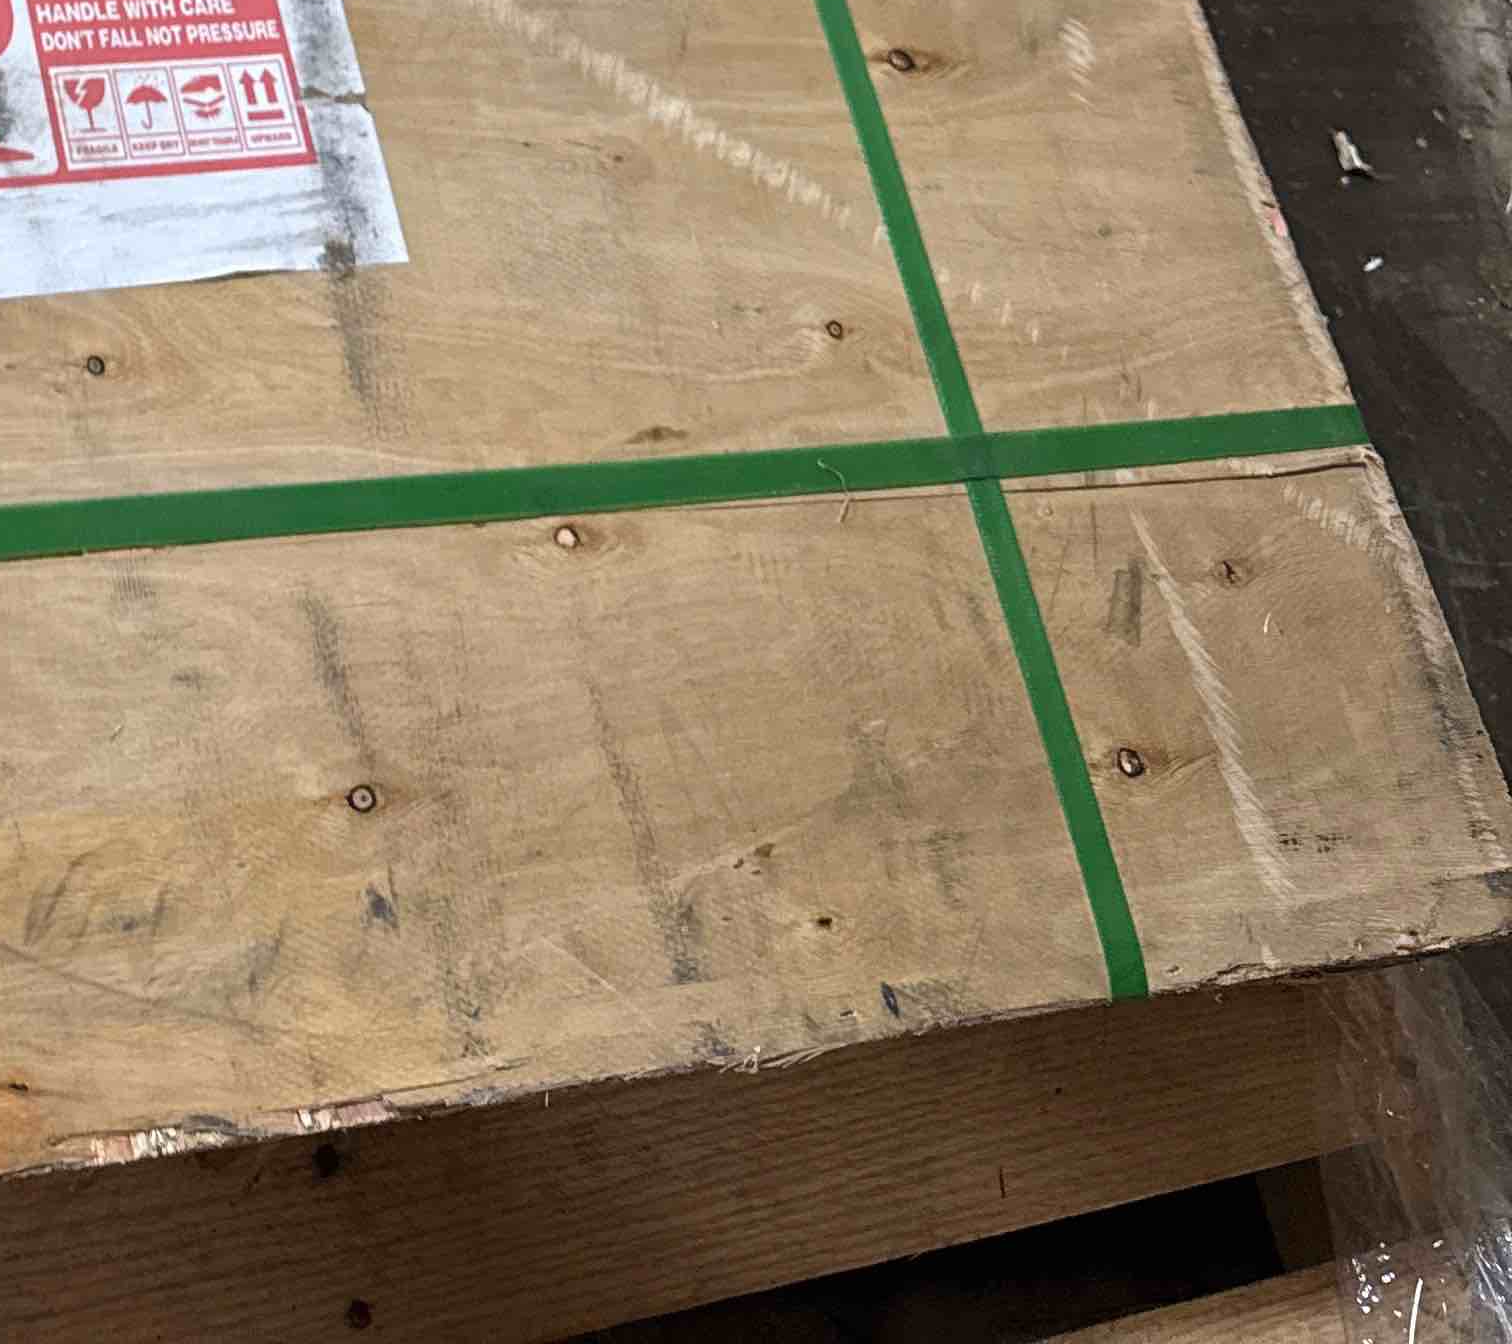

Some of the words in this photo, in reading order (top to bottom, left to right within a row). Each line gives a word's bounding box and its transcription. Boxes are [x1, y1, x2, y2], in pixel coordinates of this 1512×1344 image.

[35, 0, 121, 25] HANDLE
[40, 27, 95, 52] DON'T
[98, 24, 143, 49] FALL
[146, 23, 183, 46] NOT
[186, 18, 281, 46] PRESSURE
